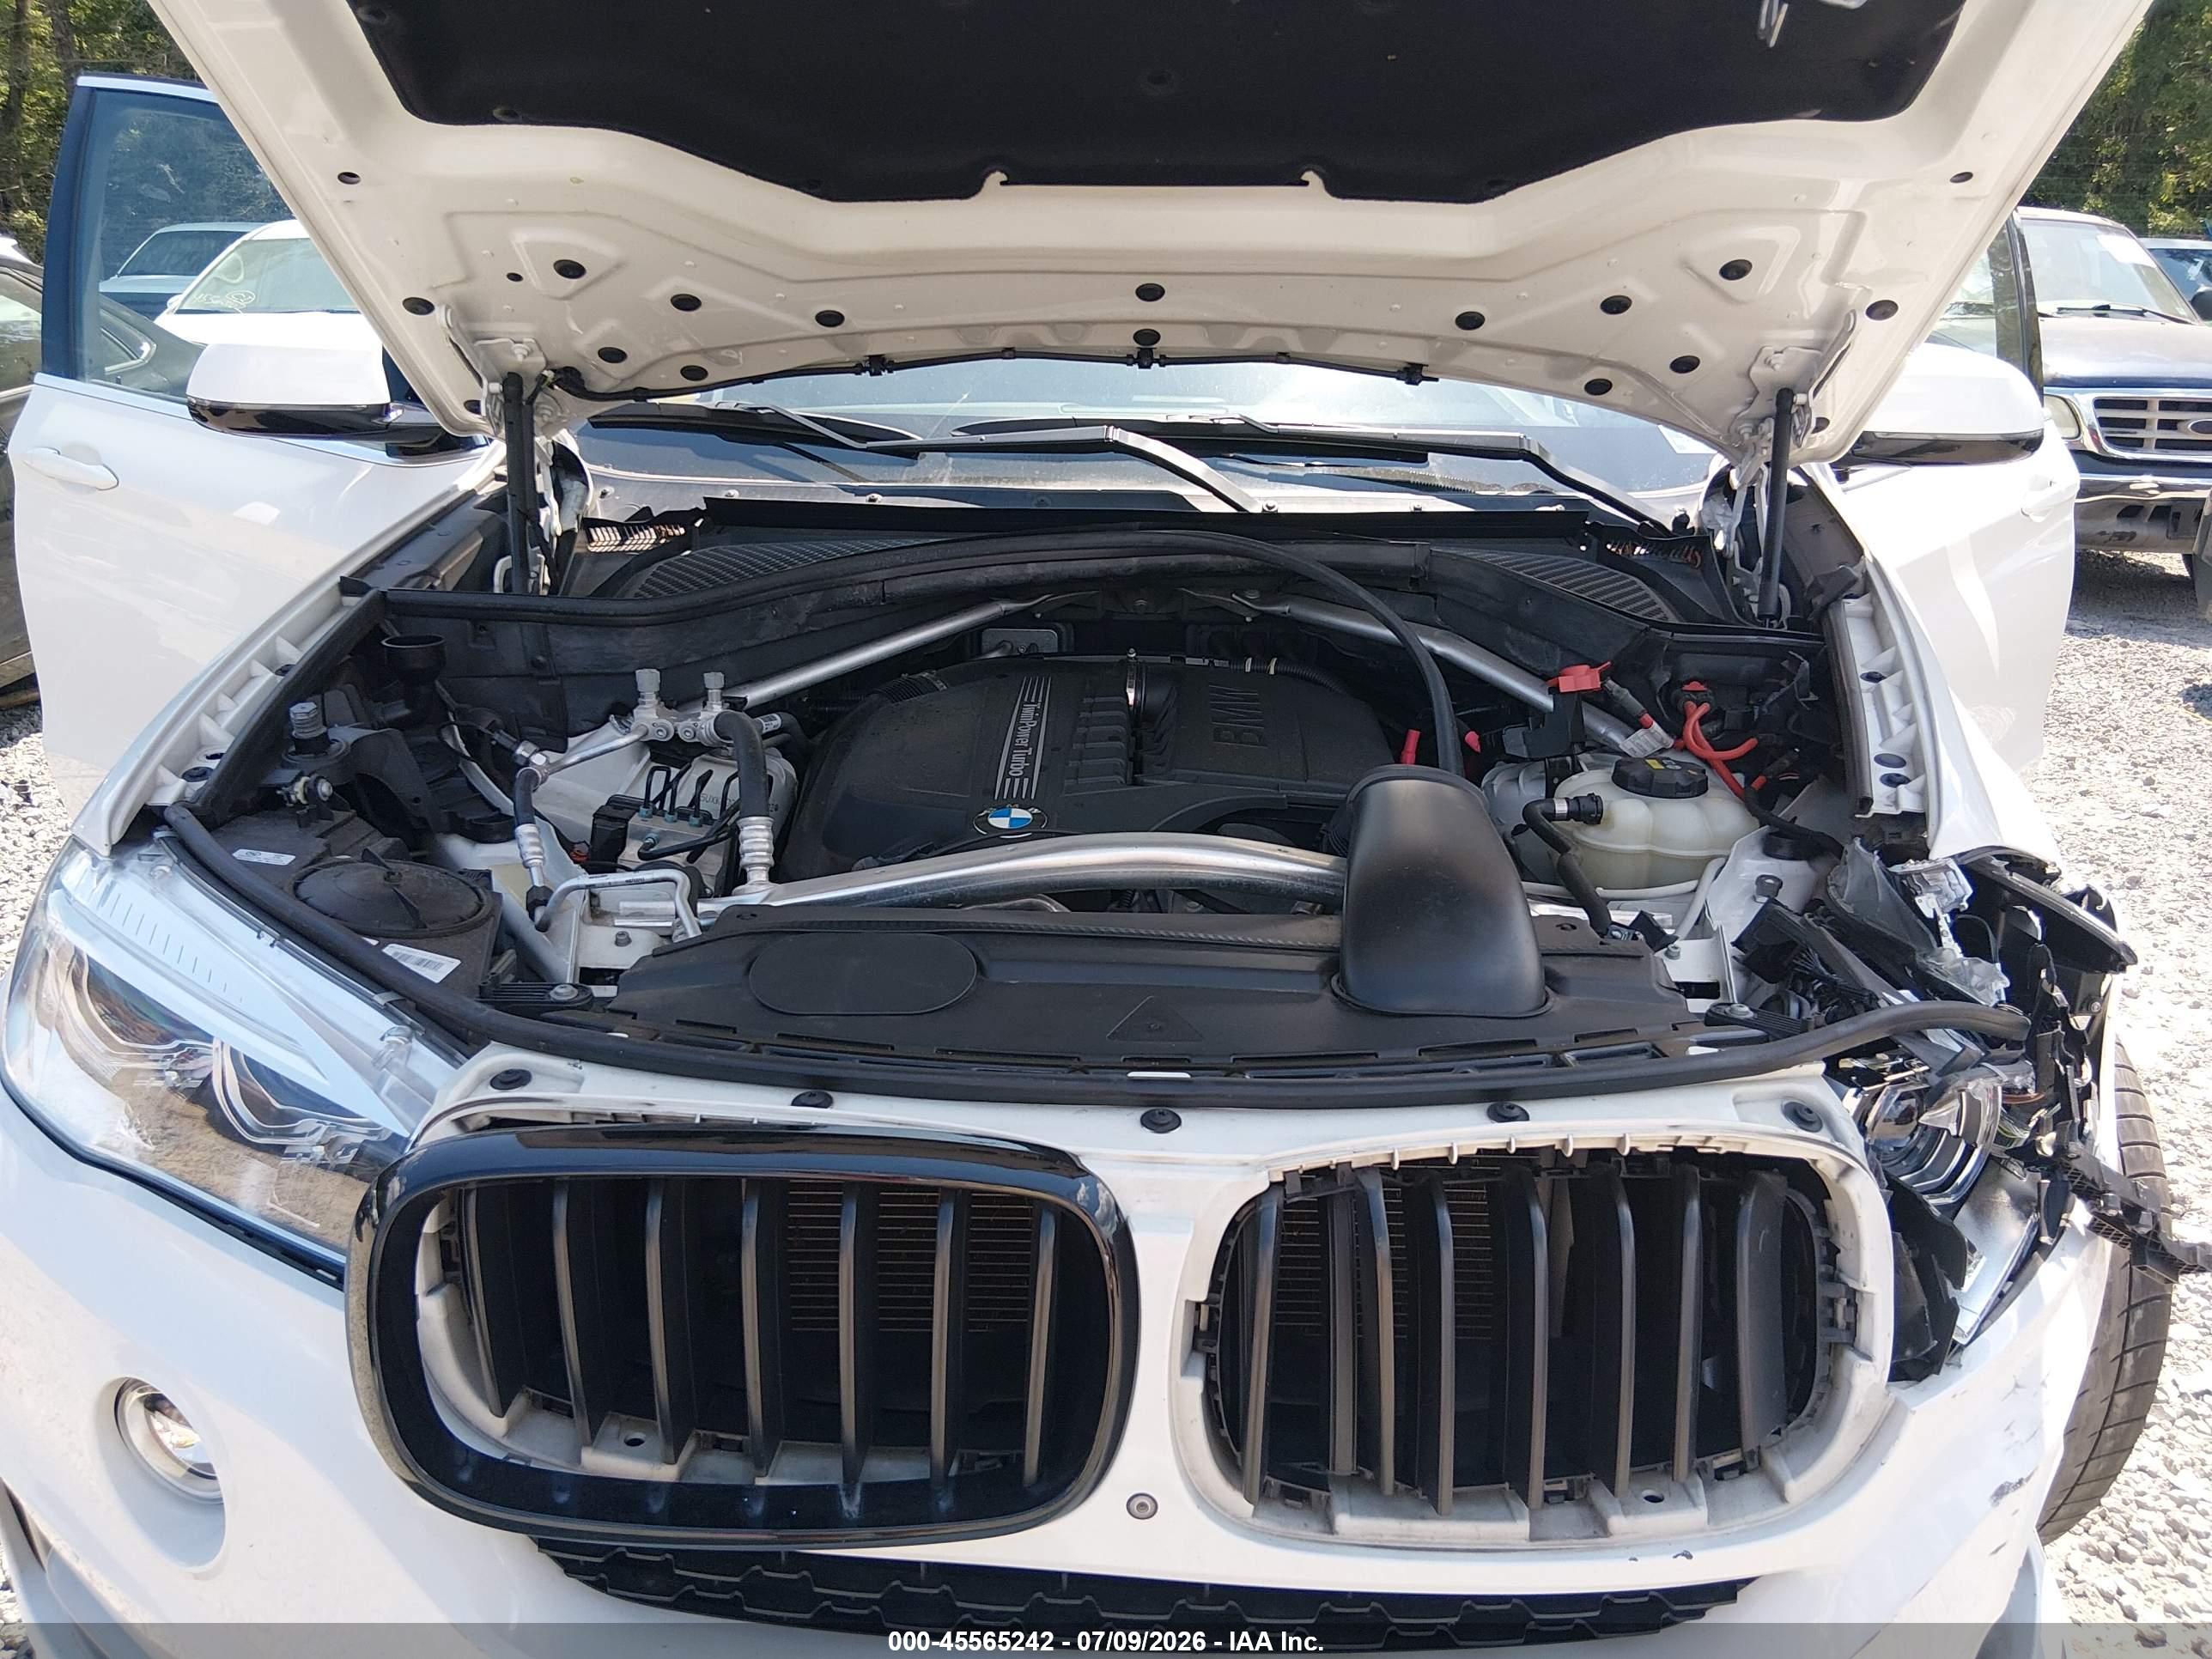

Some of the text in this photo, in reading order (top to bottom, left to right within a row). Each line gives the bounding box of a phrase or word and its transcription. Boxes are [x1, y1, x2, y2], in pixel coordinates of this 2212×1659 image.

[1014, 702, 1042, 747] TwinPower
[1208, 683, 1269, 749] BMW
[1008, 747, 1033, 776] Turbo
